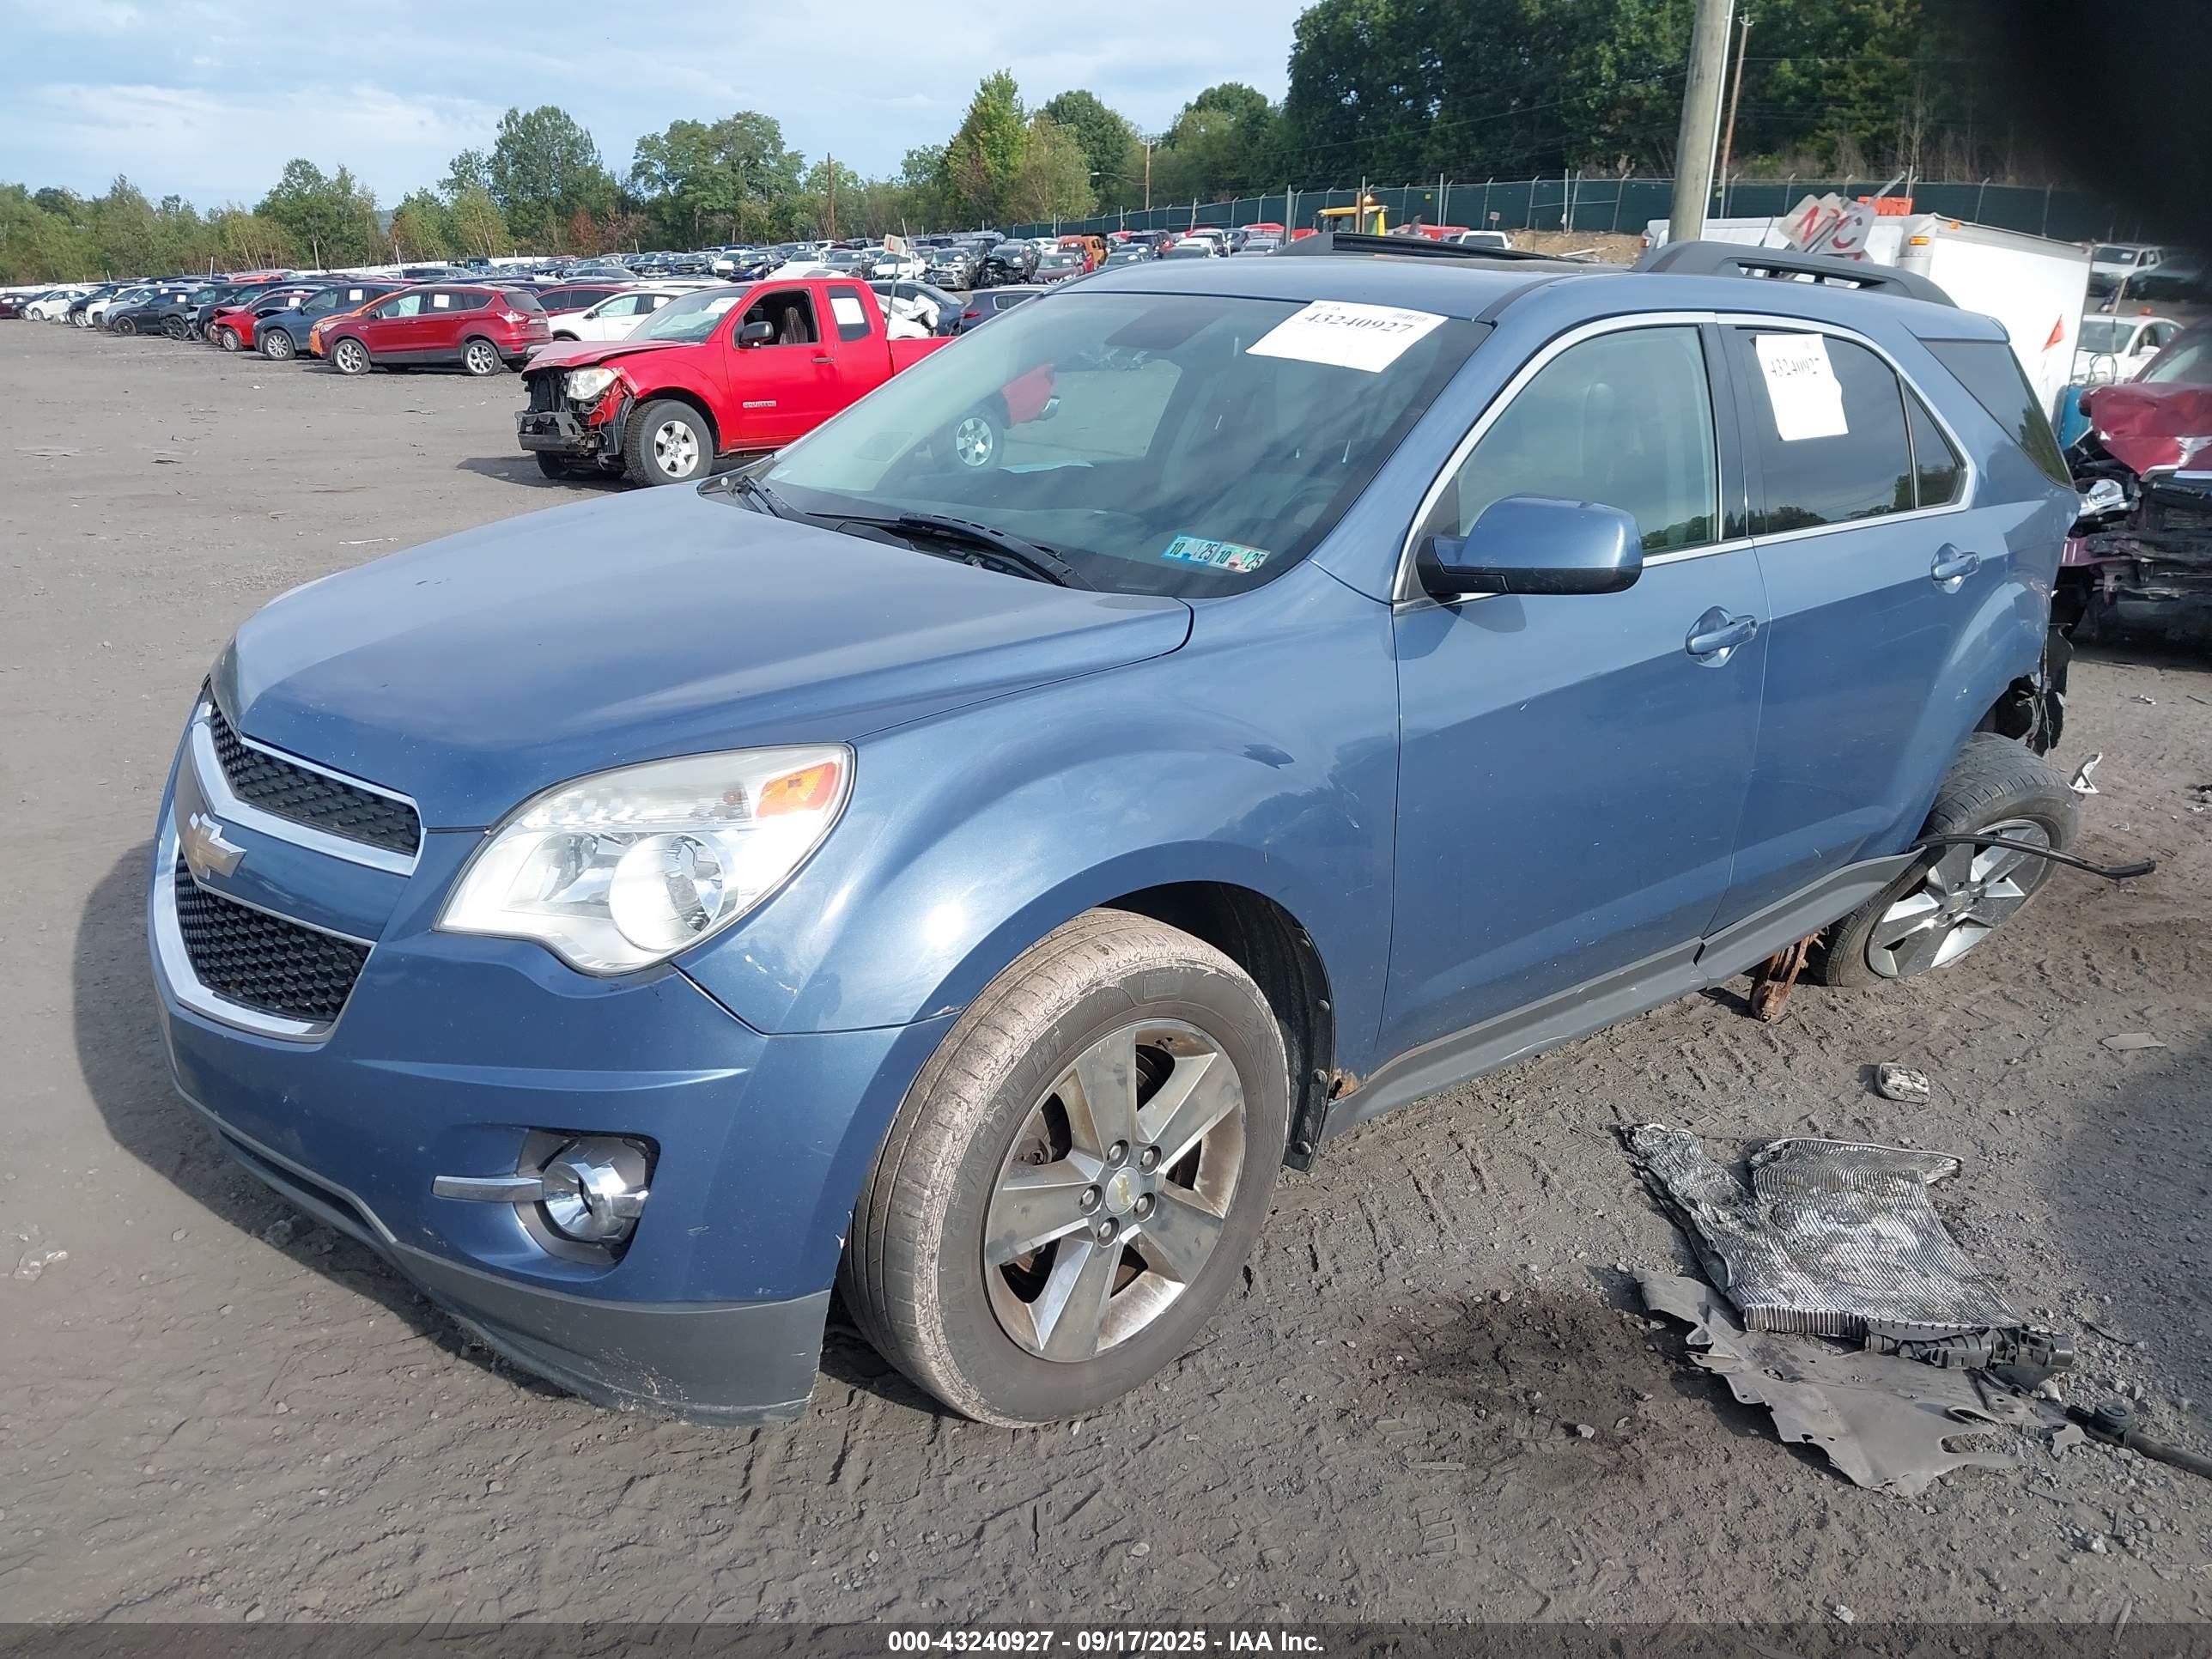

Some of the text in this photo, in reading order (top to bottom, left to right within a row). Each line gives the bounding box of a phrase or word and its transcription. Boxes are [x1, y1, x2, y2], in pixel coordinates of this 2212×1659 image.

[1304, 313, 1416, 333] 43240927
[1169, 541, 1218, 560] 10 25
[1215, 550, 1266, 569] 10 25
